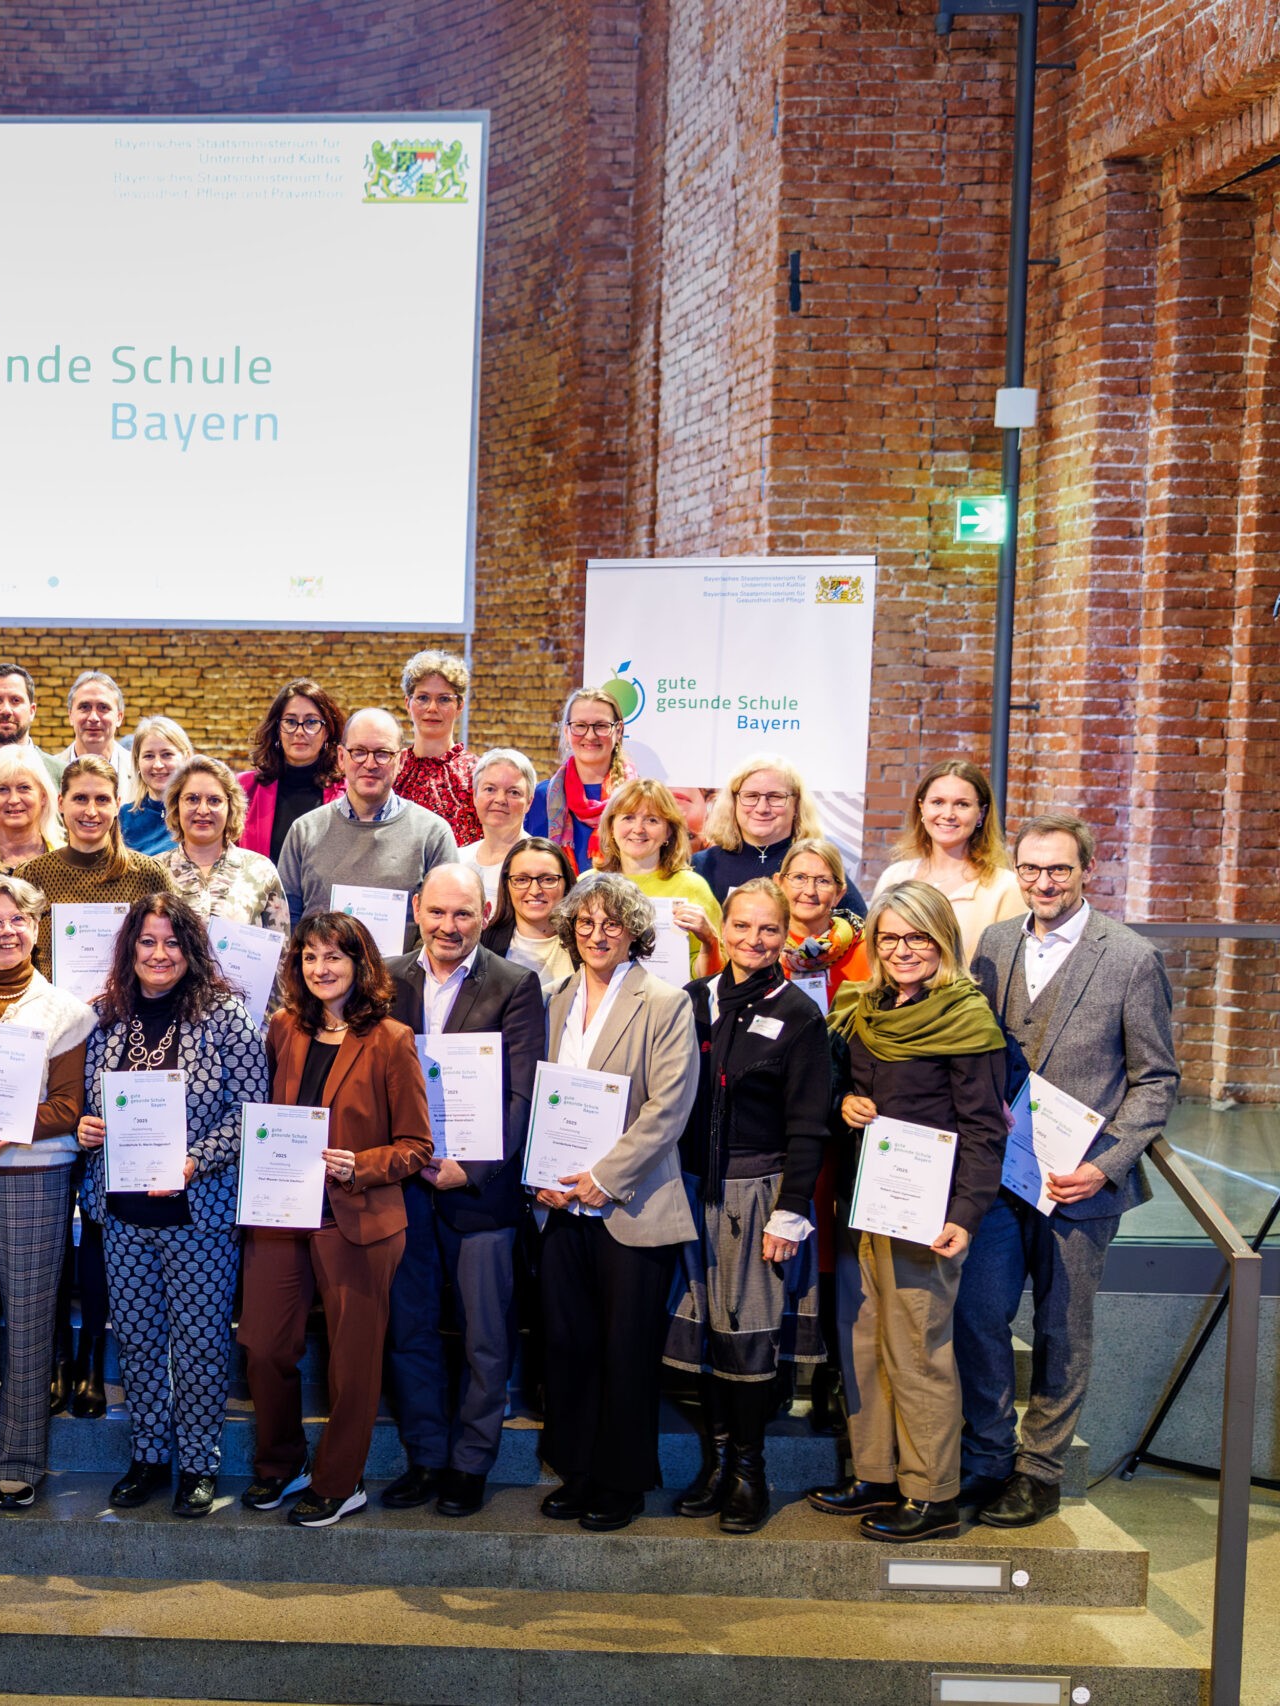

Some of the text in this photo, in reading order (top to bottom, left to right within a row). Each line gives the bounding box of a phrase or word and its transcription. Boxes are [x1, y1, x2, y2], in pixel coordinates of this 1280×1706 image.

[199, 153, 263, 164] Unterricht
[299, 153, 340, 164] Kultus
[111, 345, 272, 384] Schule
[111, 403, 279, 452] Bayern
[657, 676, 697, 694] gute
[656, 695, 799, 713] gesunde Schule
[737, 715, 800, 733] Bayern
